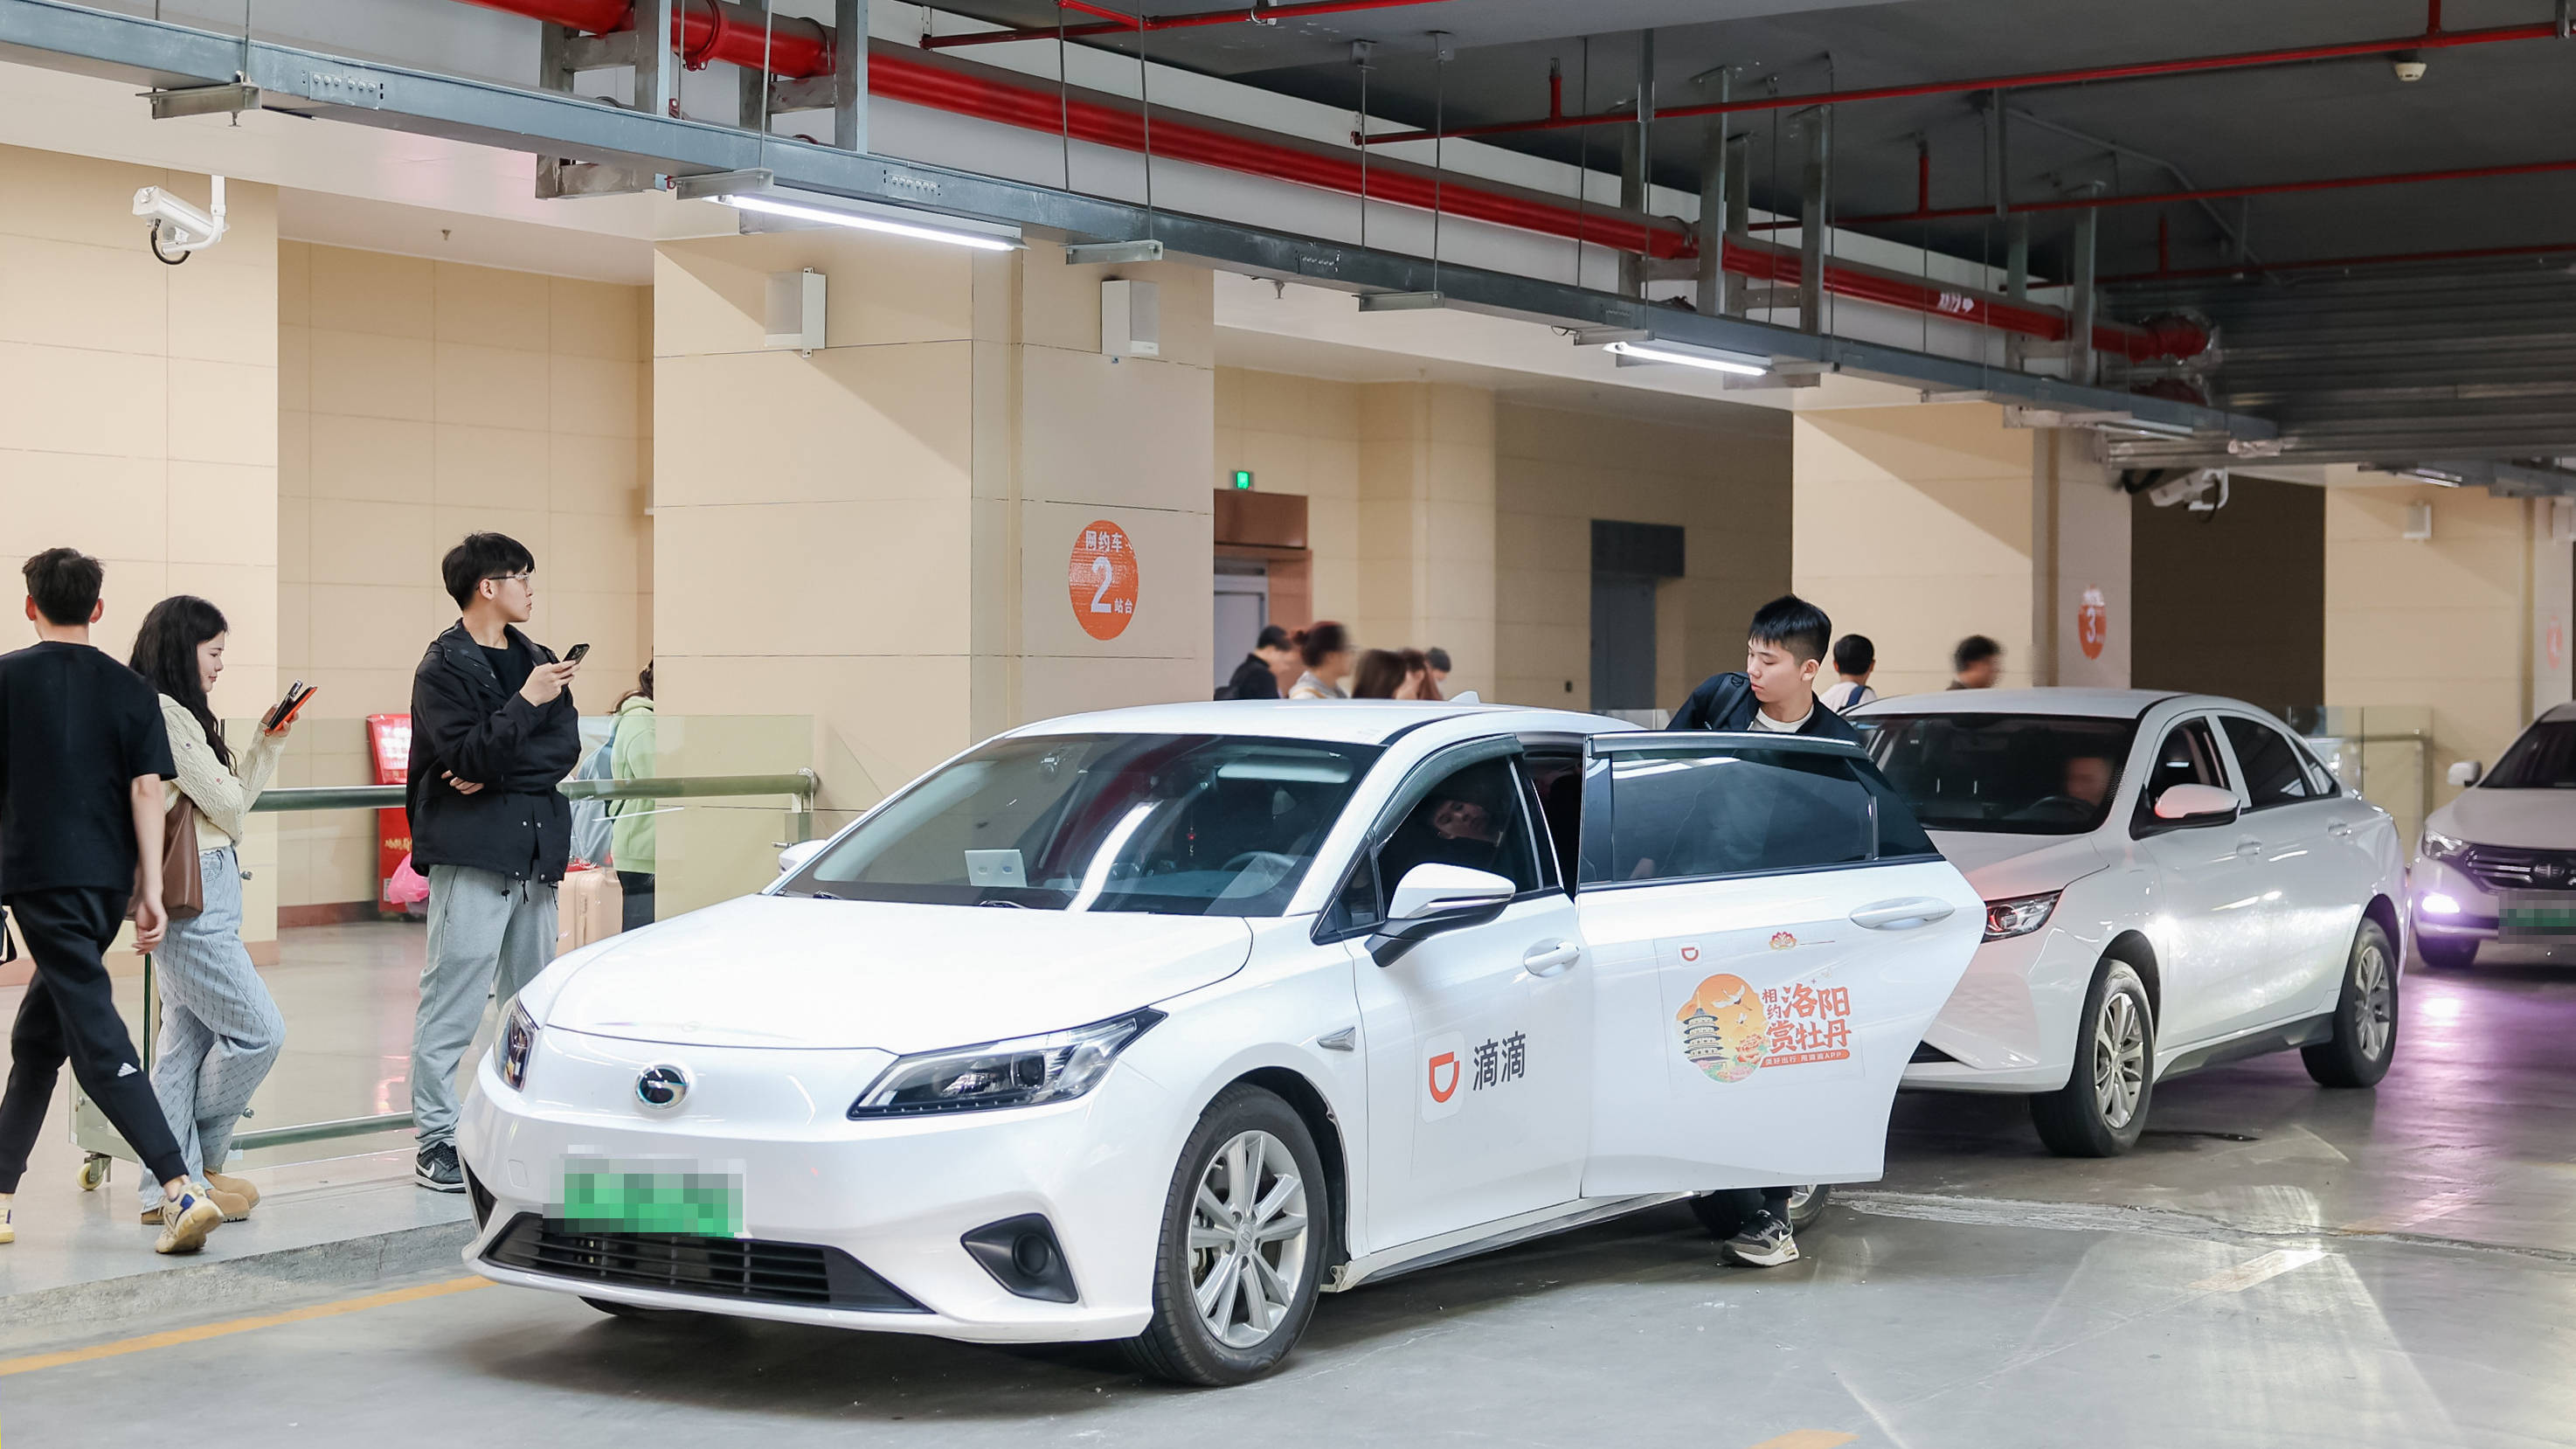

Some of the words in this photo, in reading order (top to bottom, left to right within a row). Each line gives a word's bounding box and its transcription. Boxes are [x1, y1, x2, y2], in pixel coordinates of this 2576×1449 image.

[1085, 530, 1123, 552] 网约车
[1091, 556, 1112, 614] 2
[1114, 598, 1133, 614] 站台
[2086, 607, 2096, 643] 3
[1762, 988, 1783, 1019] 相约
[1782, 982, 1851, 1020] 洛阳
[1766, 1018, 1852, 1054] 赏牡丹
[1472, 1030, 1526, 1092] 滴滴
